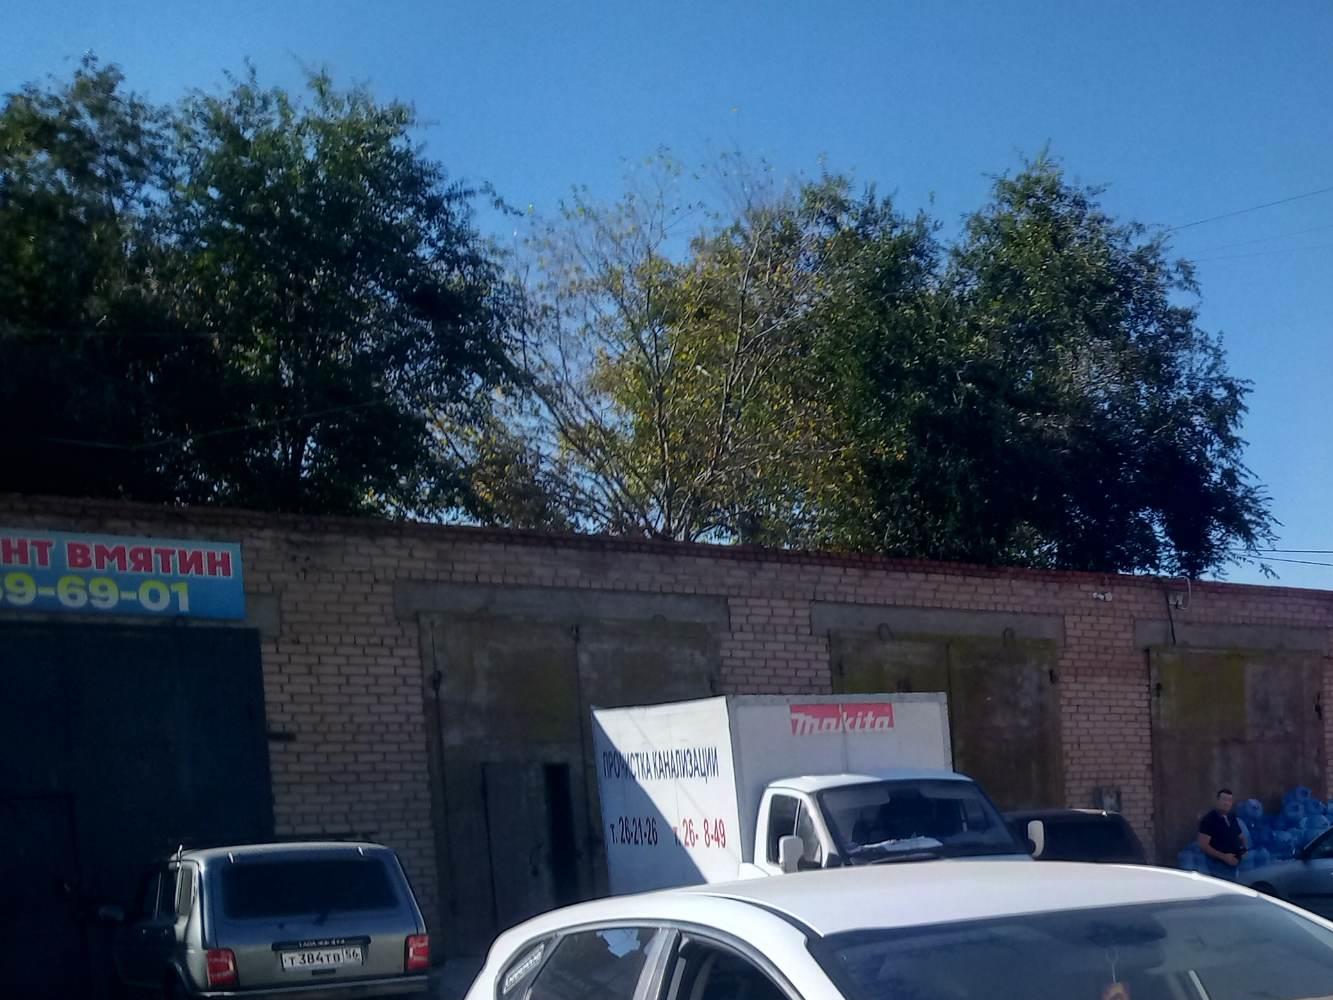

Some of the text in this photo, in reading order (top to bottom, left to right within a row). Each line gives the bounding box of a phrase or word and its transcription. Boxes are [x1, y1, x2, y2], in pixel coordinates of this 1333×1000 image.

[66, 541, 233, 577] ВМЯТИН
[0, 571, 190, 613] 9-69-01
[602, 746, 720, 784] ПРОЧИСТКА КАНАЛИЗАЦИИ
[618, 816, 659, 847] 26-21-26
